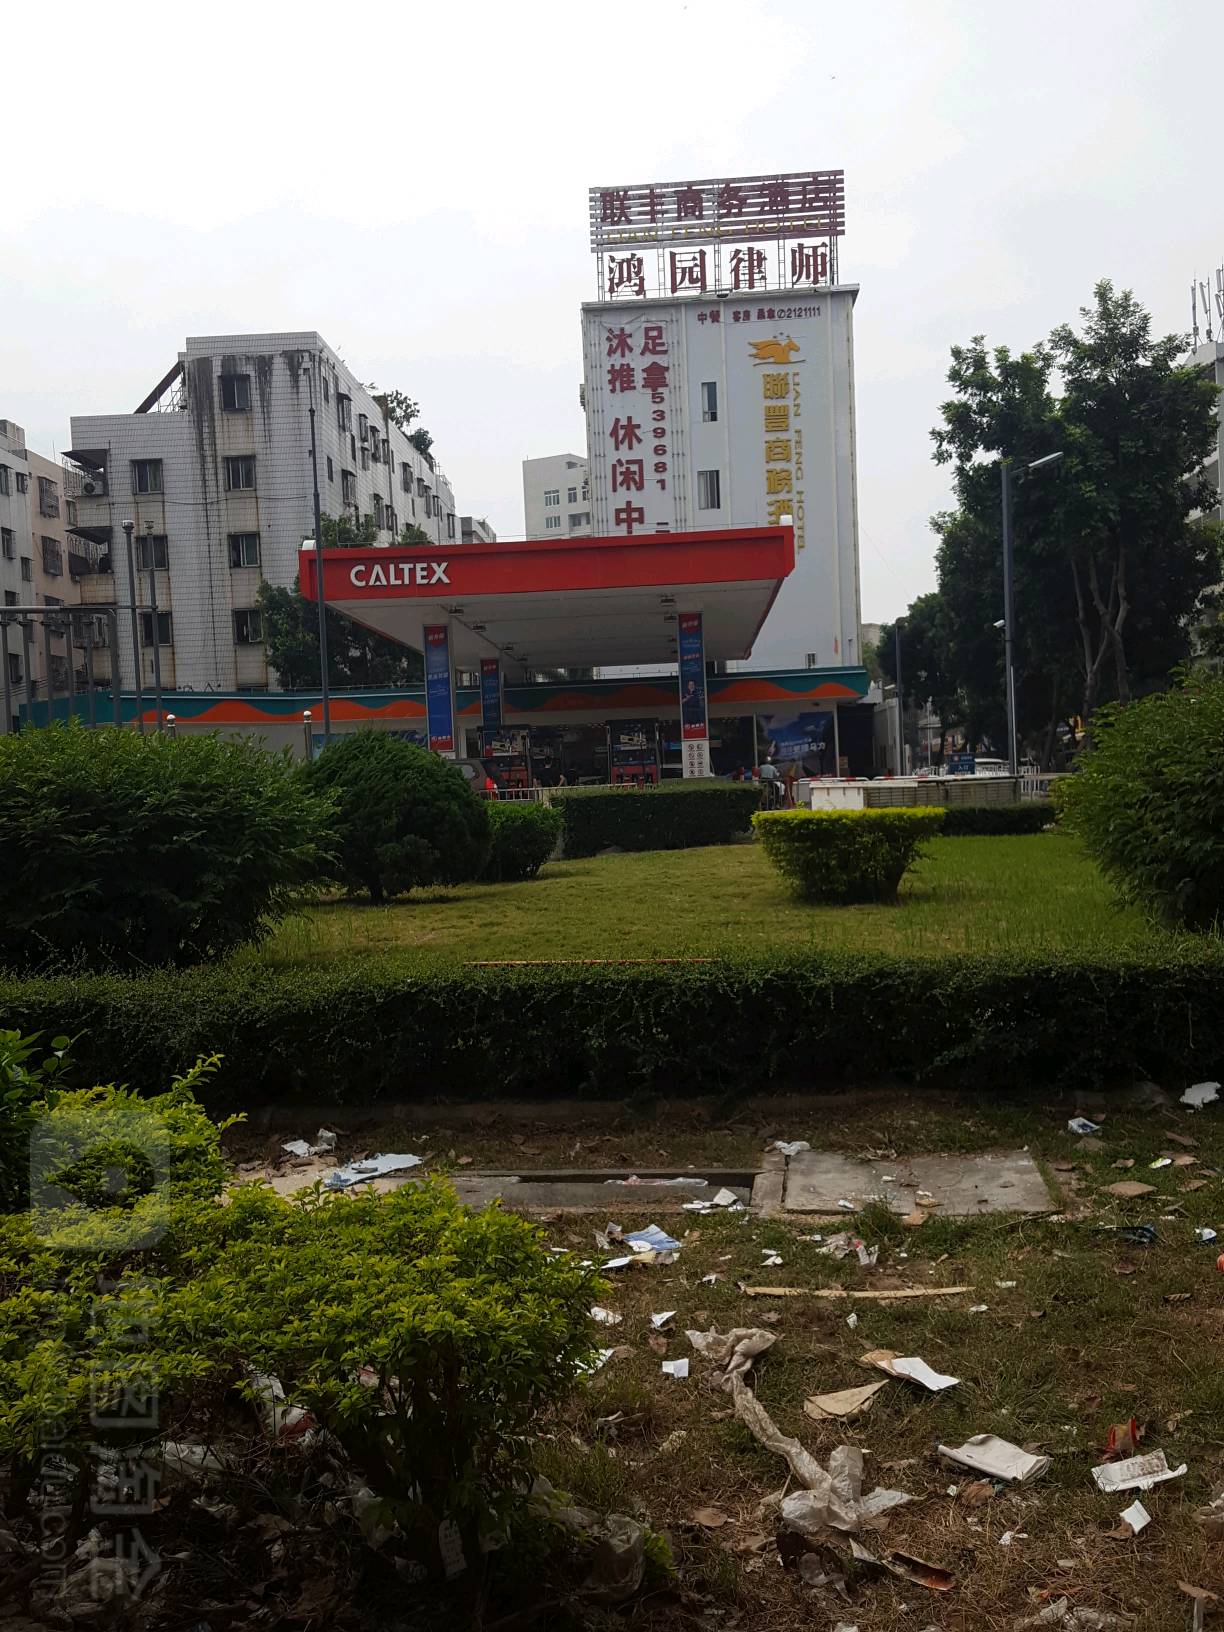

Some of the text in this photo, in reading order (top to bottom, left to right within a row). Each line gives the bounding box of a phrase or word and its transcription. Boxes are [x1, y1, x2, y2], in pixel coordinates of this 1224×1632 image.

[600, 175, 830, 225] 联丰商务酒店
[606, 216, 831, 244] LIAN FENG HOTEL
[608, 242, 828, 297] 鸿园律师
[605, 325, 669, 359] 沐足
[607, 361, 670, 395] 推拿
[651, 392, 668, 491] 539681
[792, 371, 806, 555] LIAN FENG HOTEL
[349, 561, 451, 588] CALTEX
